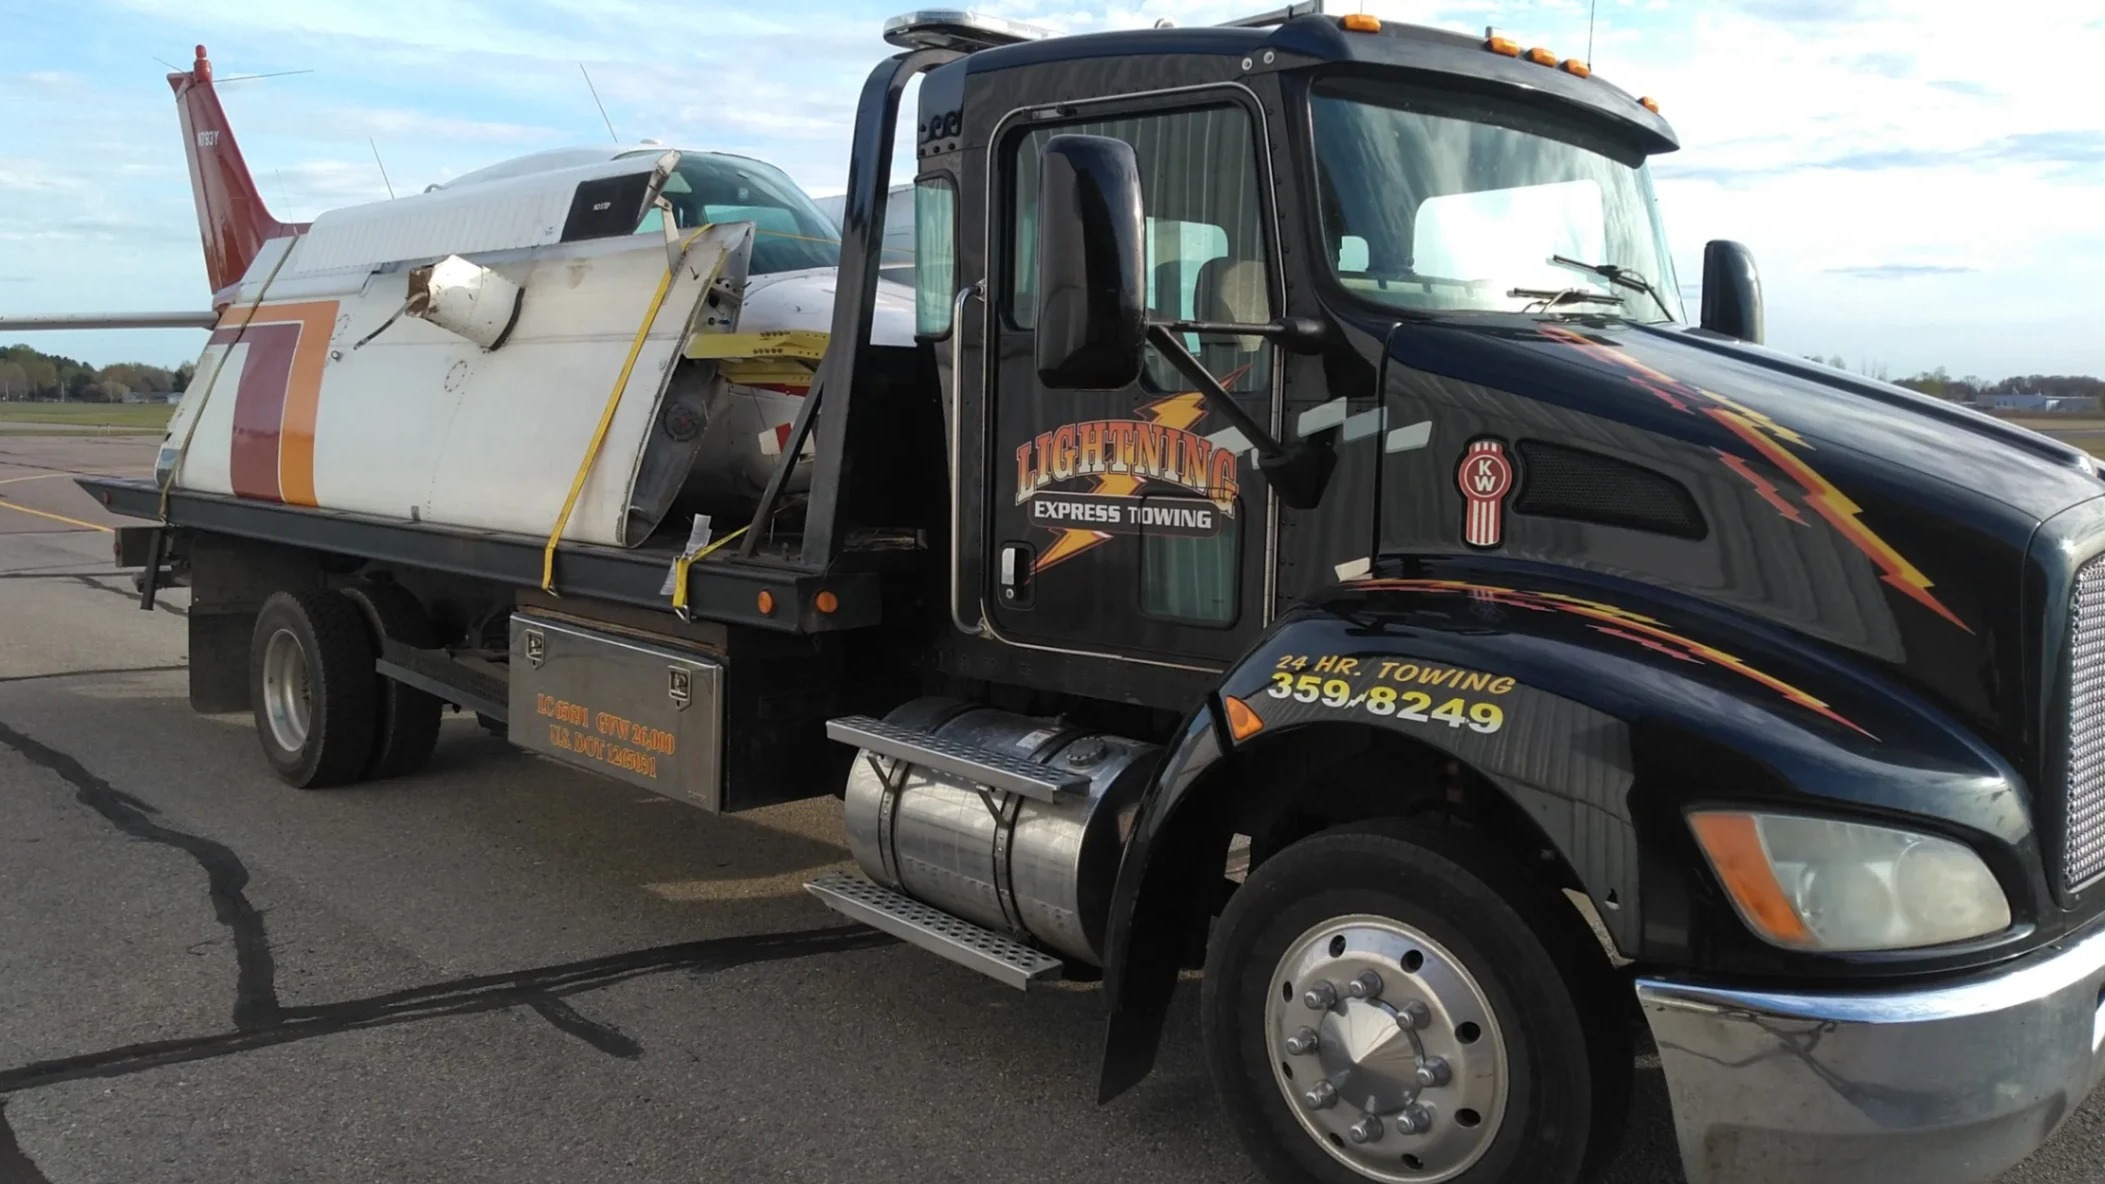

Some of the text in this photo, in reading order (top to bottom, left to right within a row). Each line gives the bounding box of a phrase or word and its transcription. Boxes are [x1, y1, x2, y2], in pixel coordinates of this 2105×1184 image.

[1015, 419, 1239, 519] LIGHTNING
[1034, 501, 1212, 529] EXPRESS TOWING
[1276, 655, 1517, 695] 24 HR. TOWING
[573, 731, 605, 760] DOT
